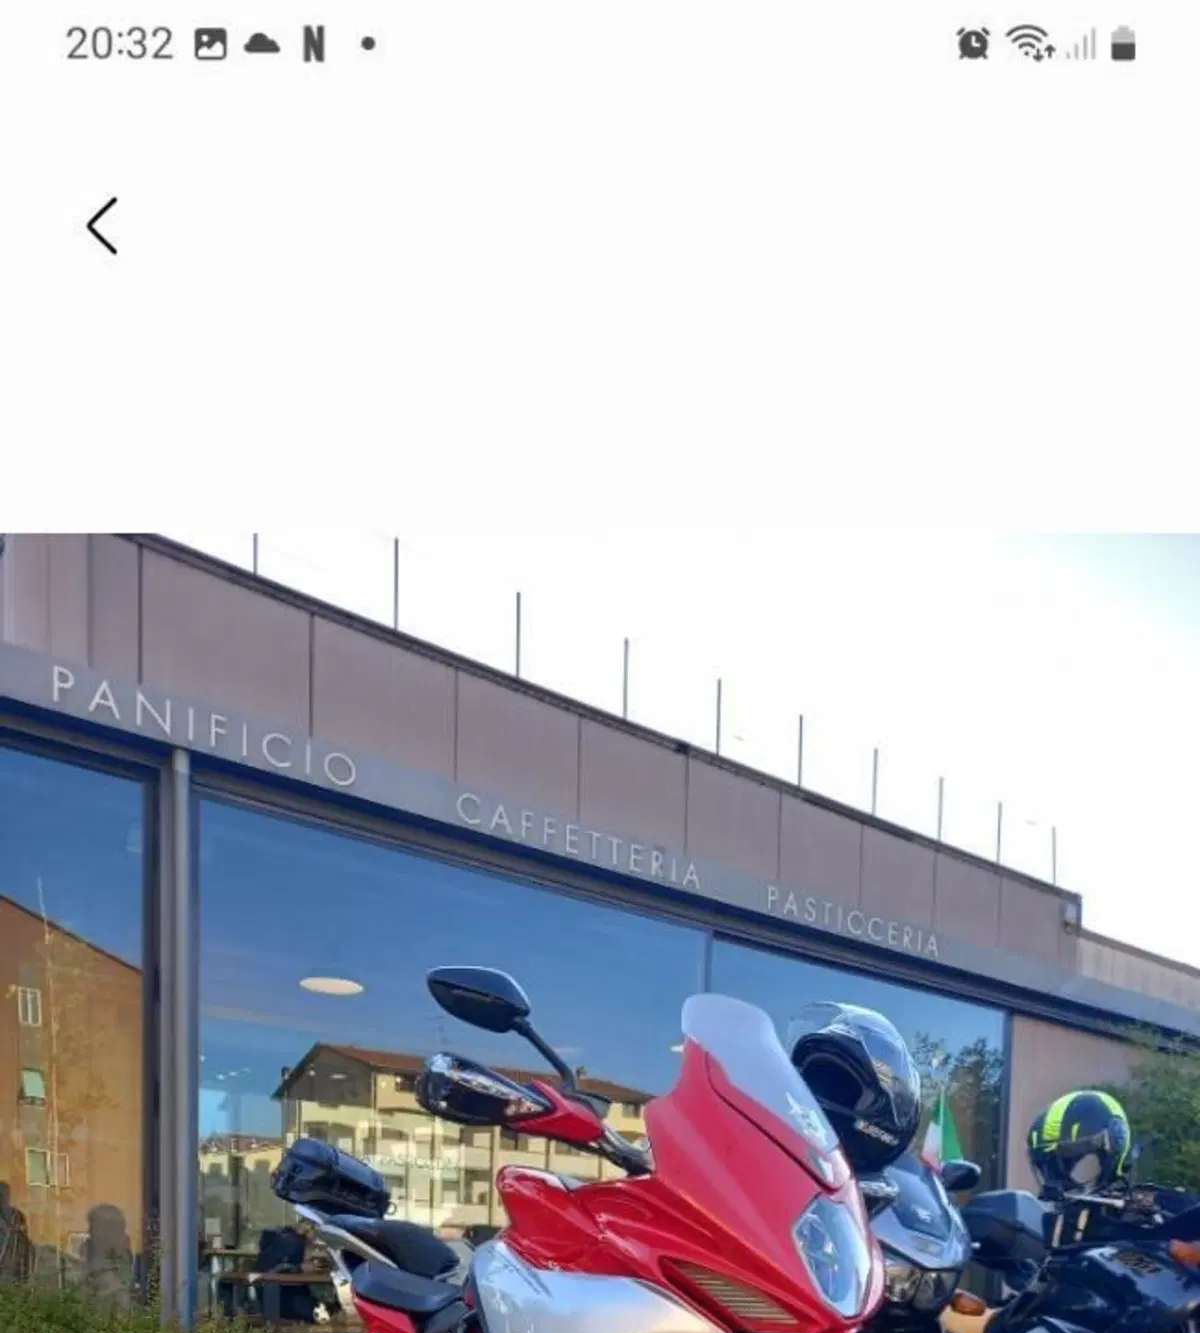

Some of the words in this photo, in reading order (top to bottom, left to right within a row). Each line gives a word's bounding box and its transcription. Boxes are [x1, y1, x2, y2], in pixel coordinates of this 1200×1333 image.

[51, 665, 358, 787] PANIFICIO
[456, 792, 702, 889] CAFFETTERIA
[766, 885, 940, 958] PASTICCERIA
